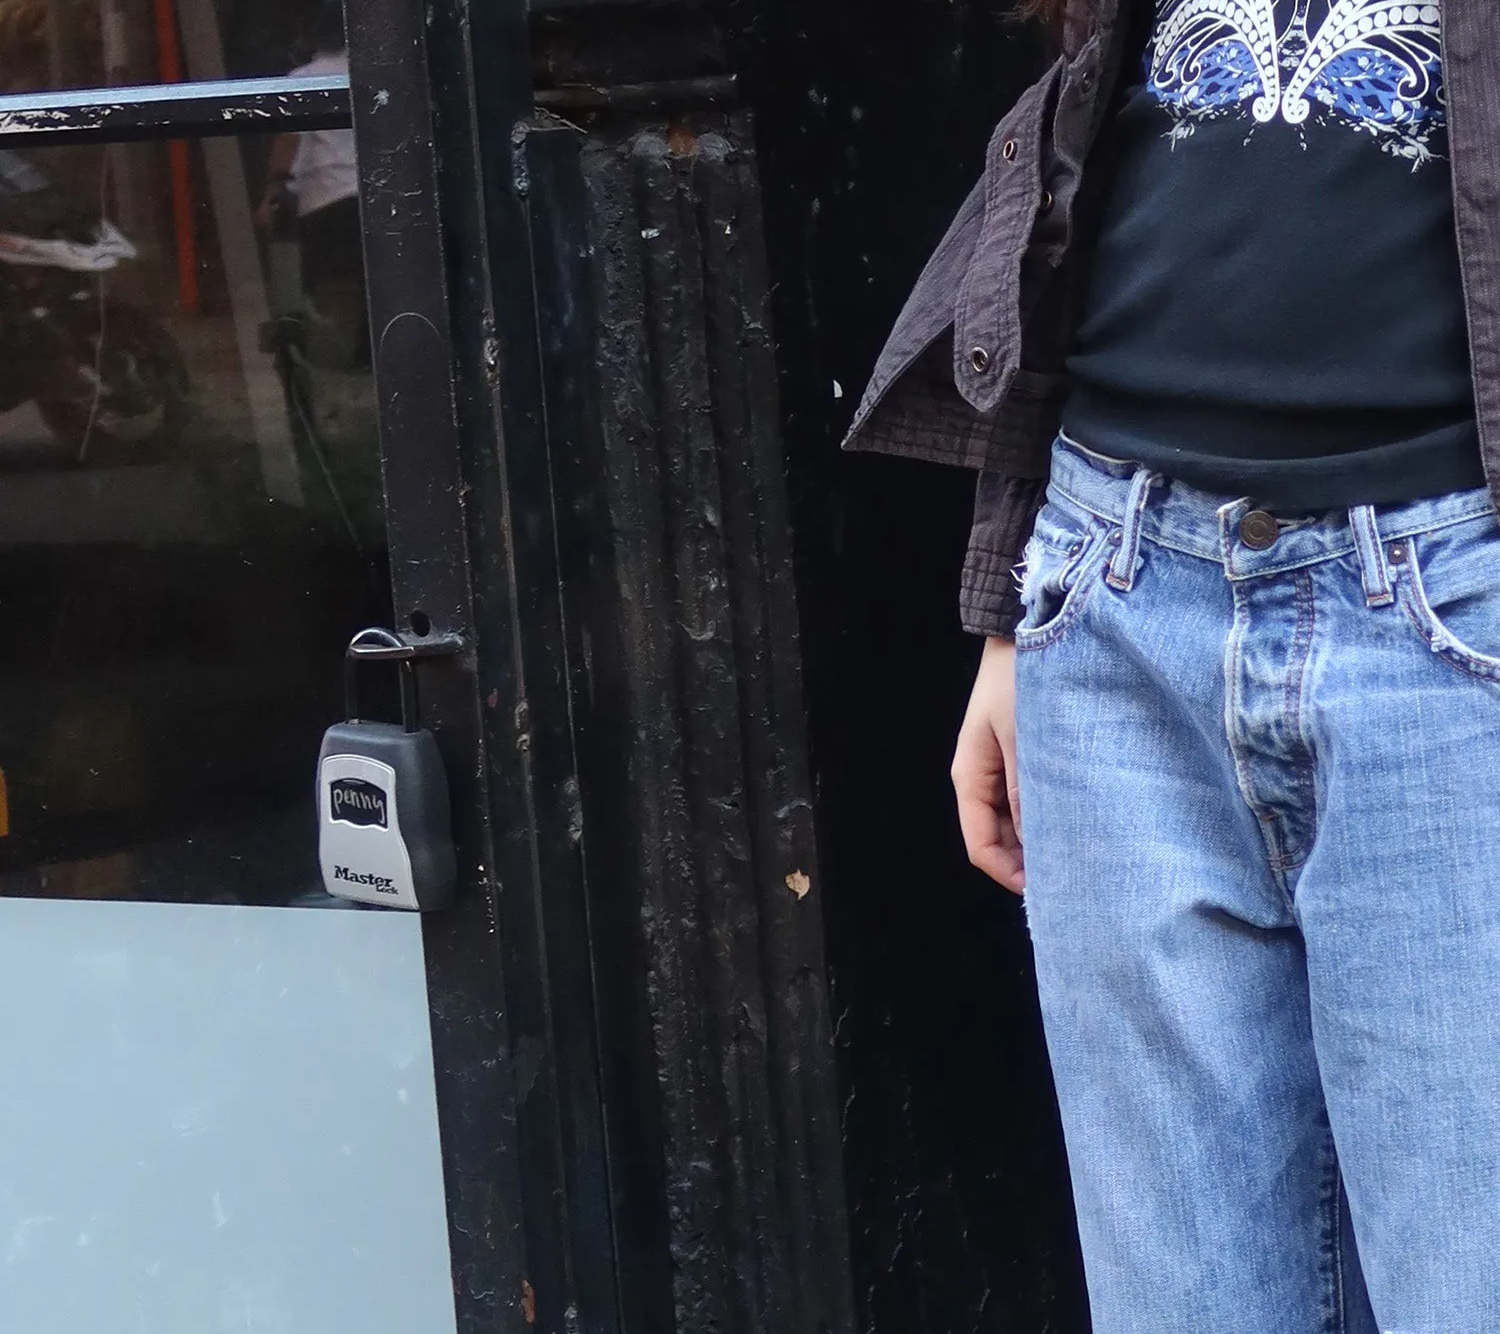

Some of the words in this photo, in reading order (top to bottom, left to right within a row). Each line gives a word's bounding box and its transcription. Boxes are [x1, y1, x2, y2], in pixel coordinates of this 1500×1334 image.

[333, 787, 387, 825] penny
[333, 865, 395, 889] Master
[376, 883, 400, 896] Lock
